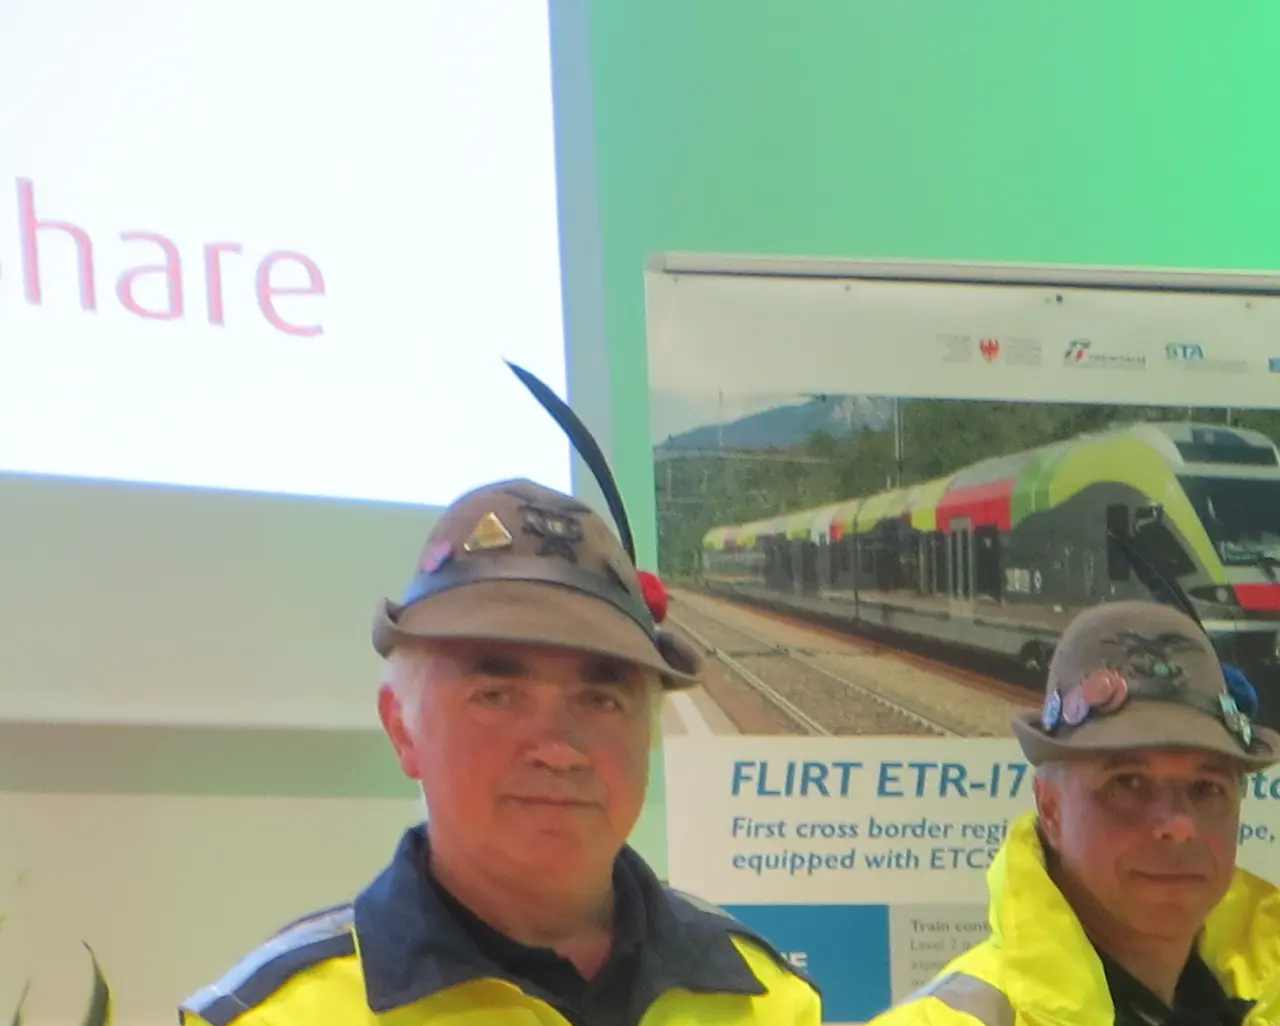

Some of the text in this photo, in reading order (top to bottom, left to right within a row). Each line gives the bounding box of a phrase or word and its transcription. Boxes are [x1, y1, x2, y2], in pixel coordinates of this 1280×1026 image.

[3, 175, 326, 337] hare
[730, 760, 863, 798] FLIRT
[876, 760, 1029, 798] ETR-17
[731, 816, 1275, 846] First cross border regi pe,
[732, 847, 856, 877] equipped
[864, 848, 920, 871] with
[910, 919, 950, 933] Train
[954, 920, 993, 933] cont
